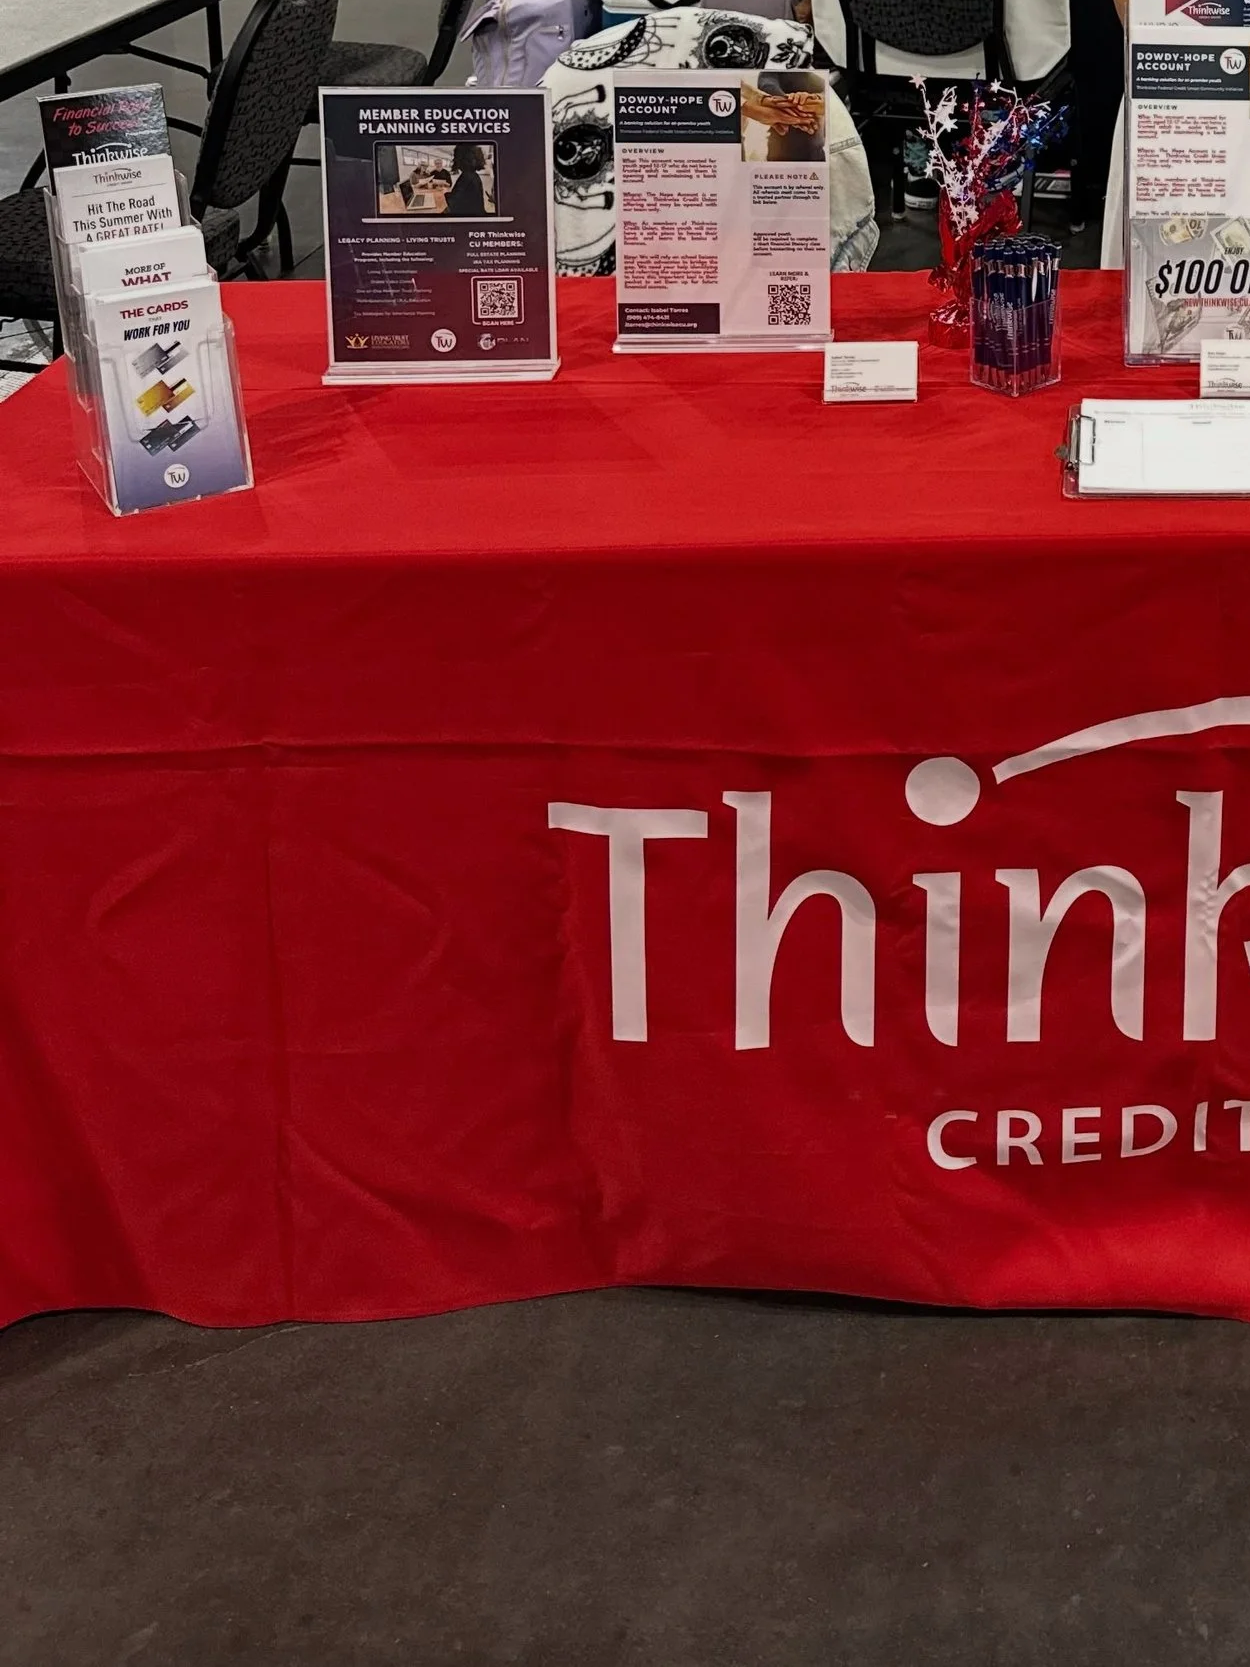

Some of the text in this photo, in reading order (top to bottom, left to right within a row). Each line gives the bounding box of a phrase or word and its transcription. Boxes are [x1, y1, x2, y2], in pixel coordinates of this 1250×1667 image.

[1187, 2, 1230, 15] Thinkwise
[1137, 52, 1215, 62] DOWDY-HOPE
[1137, 62, 1191, 71] ACCOUNT
[619, 96, 703, 104] DOWDY-HOPE
[53, 104, 114, 122] Financial
[359, 109, 509, 120] MEMBER EDUCATION
[619, 106, 677, 114] ACCOUNT
[68, 123, 80, 136] to
[359, 122, 510, 134] PLANNING SERVICES
[72, 143, 148, 166] Thinkwise
[94, 168, 142, 184] Thinkwise
[88, 196, 155, 215] Hit The Road
[73, 207, 172, 232] This Summer With
[1225, 247, 1244, 255] ENJOY
[125, 263, 166, 275] MORE OF
[122, 272, 171, 286] WHAT
[1156, 260, 1224, 298] $100
[1184, 298, 1199, 306] NEW
[1200, 298, 1238, 306] THINKWISE
[1239, 298, 1249, 306] CU
[120, 300, 189, 320] THE CARDS
[124, 319, 190, 341] WORK FOR YOU
